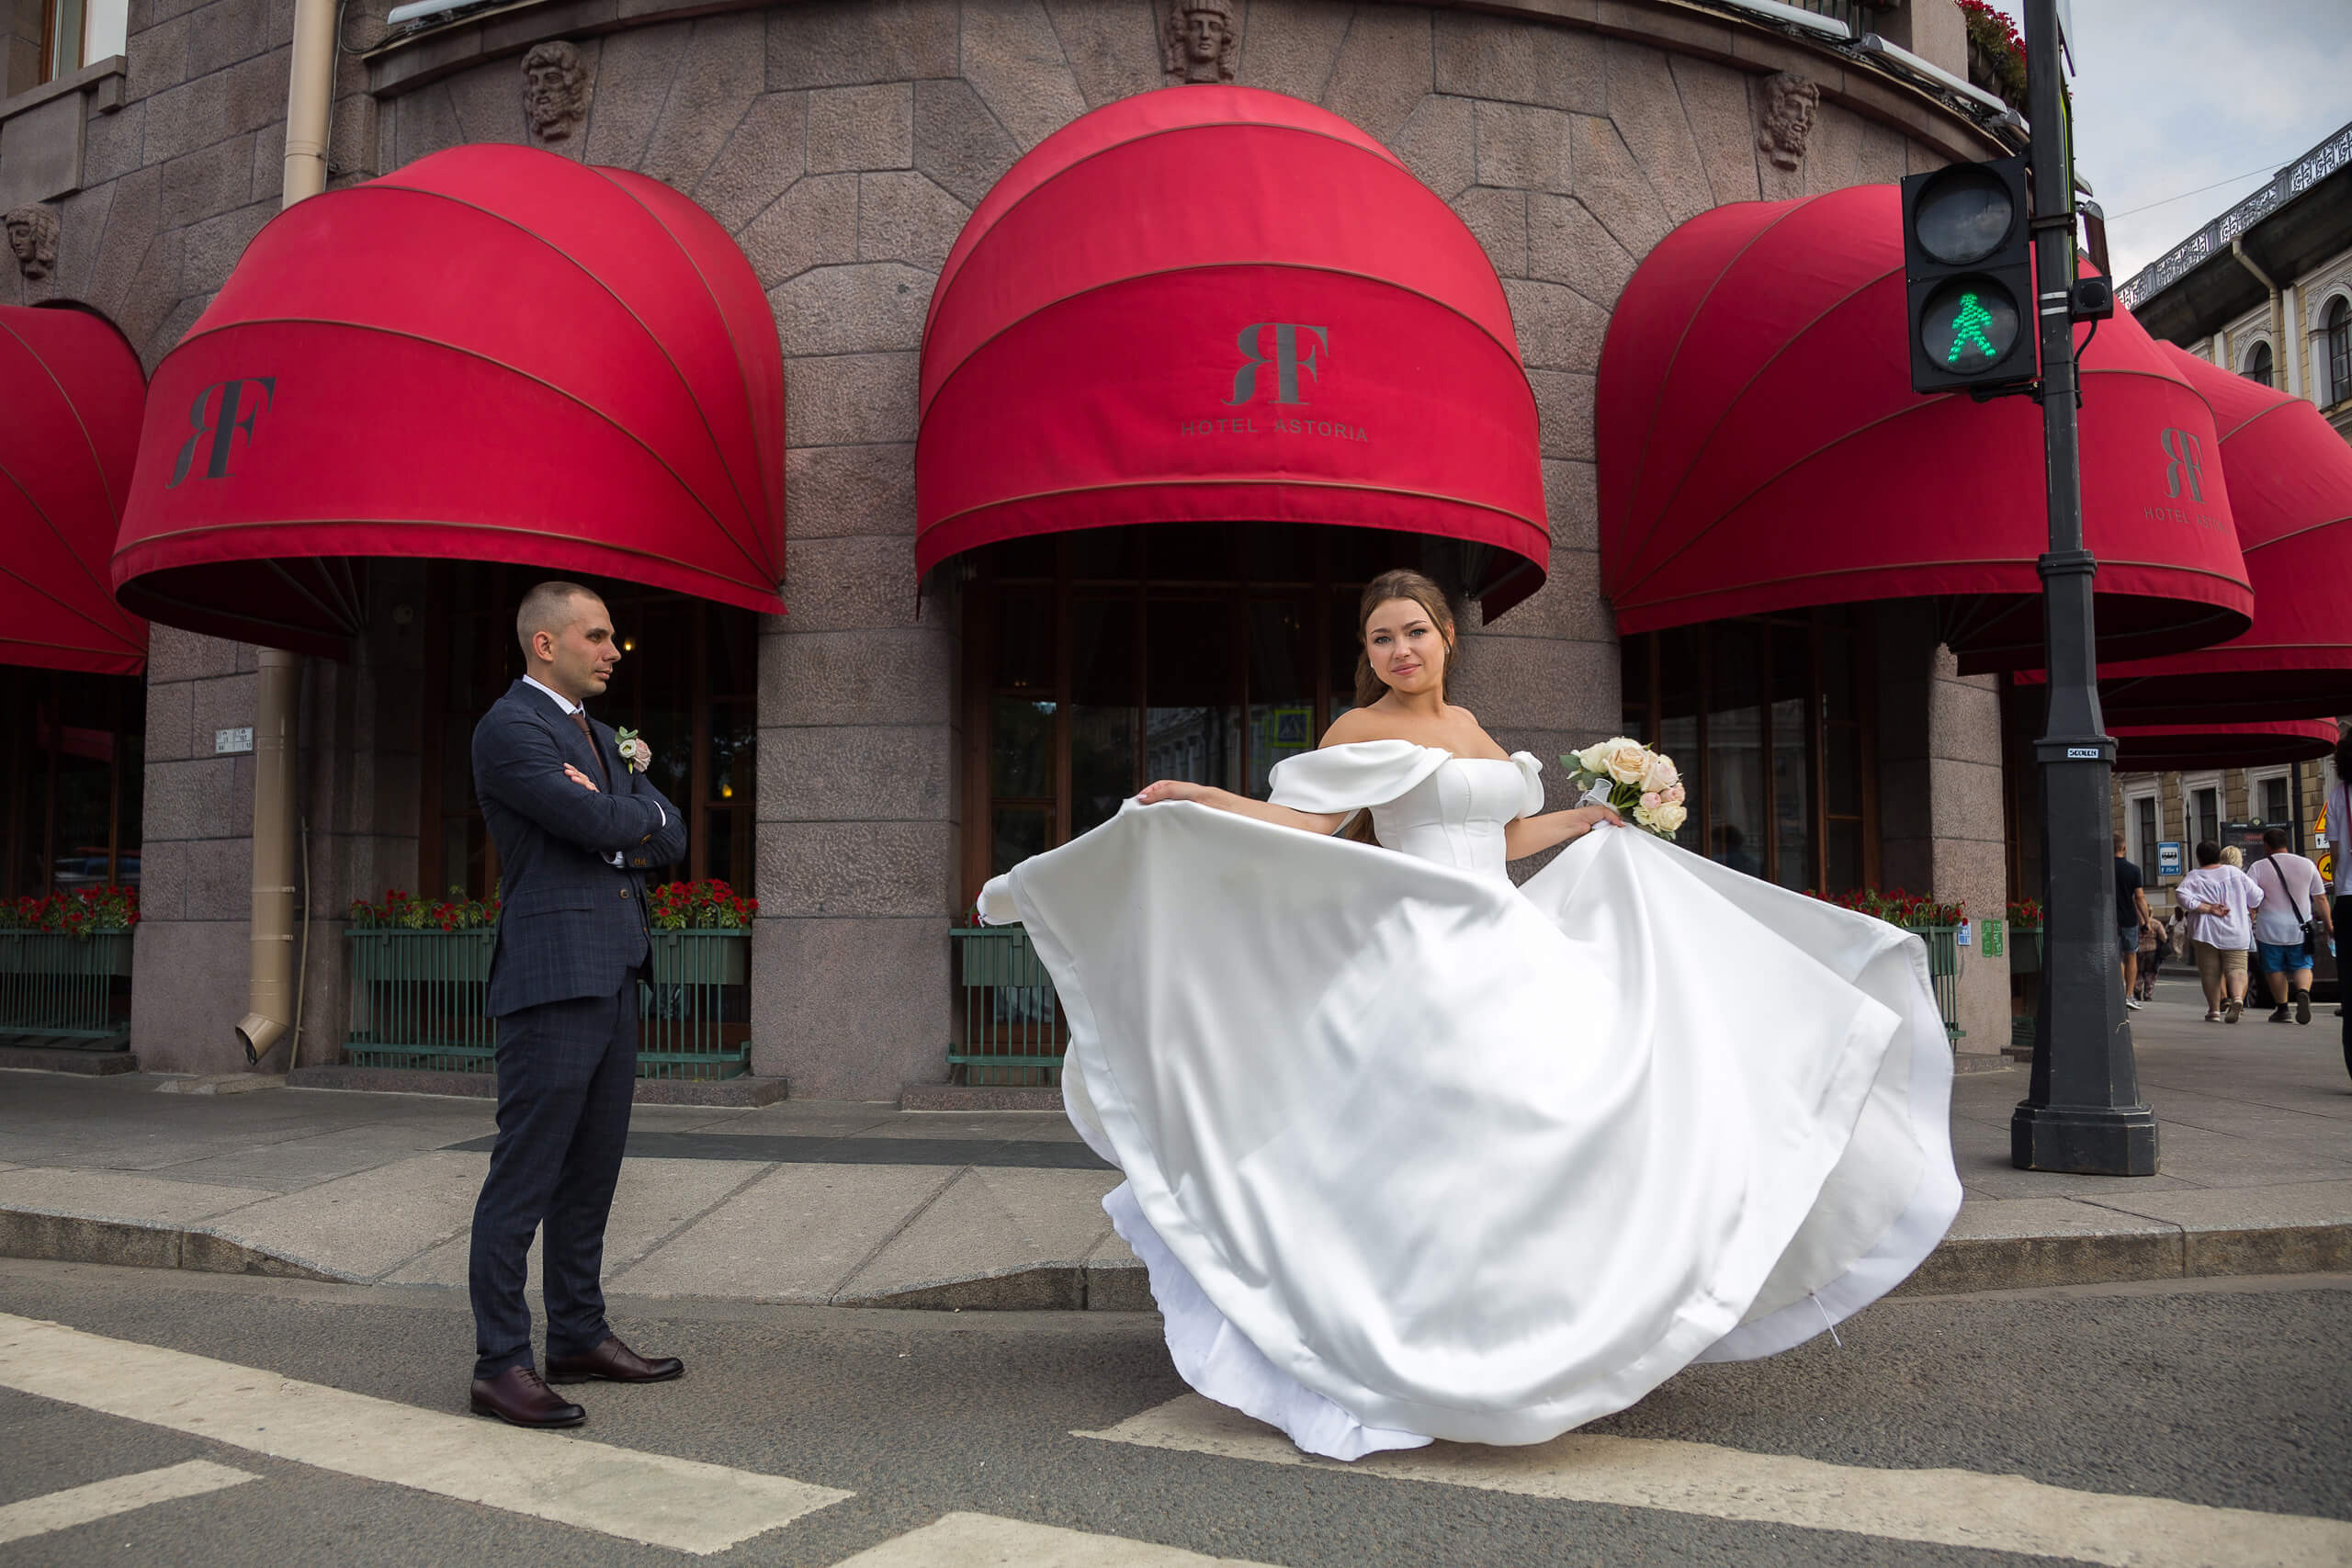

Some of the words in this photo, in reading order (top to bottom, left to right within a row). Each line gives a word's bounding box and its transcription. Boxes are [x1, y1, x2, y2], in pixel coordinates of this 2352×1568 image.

[1182, 418, 1258, 436] HOTEL
[1274, 418, 1369, 442] ASTORIA
[2143, 506, 2191, 524] HOTEL
